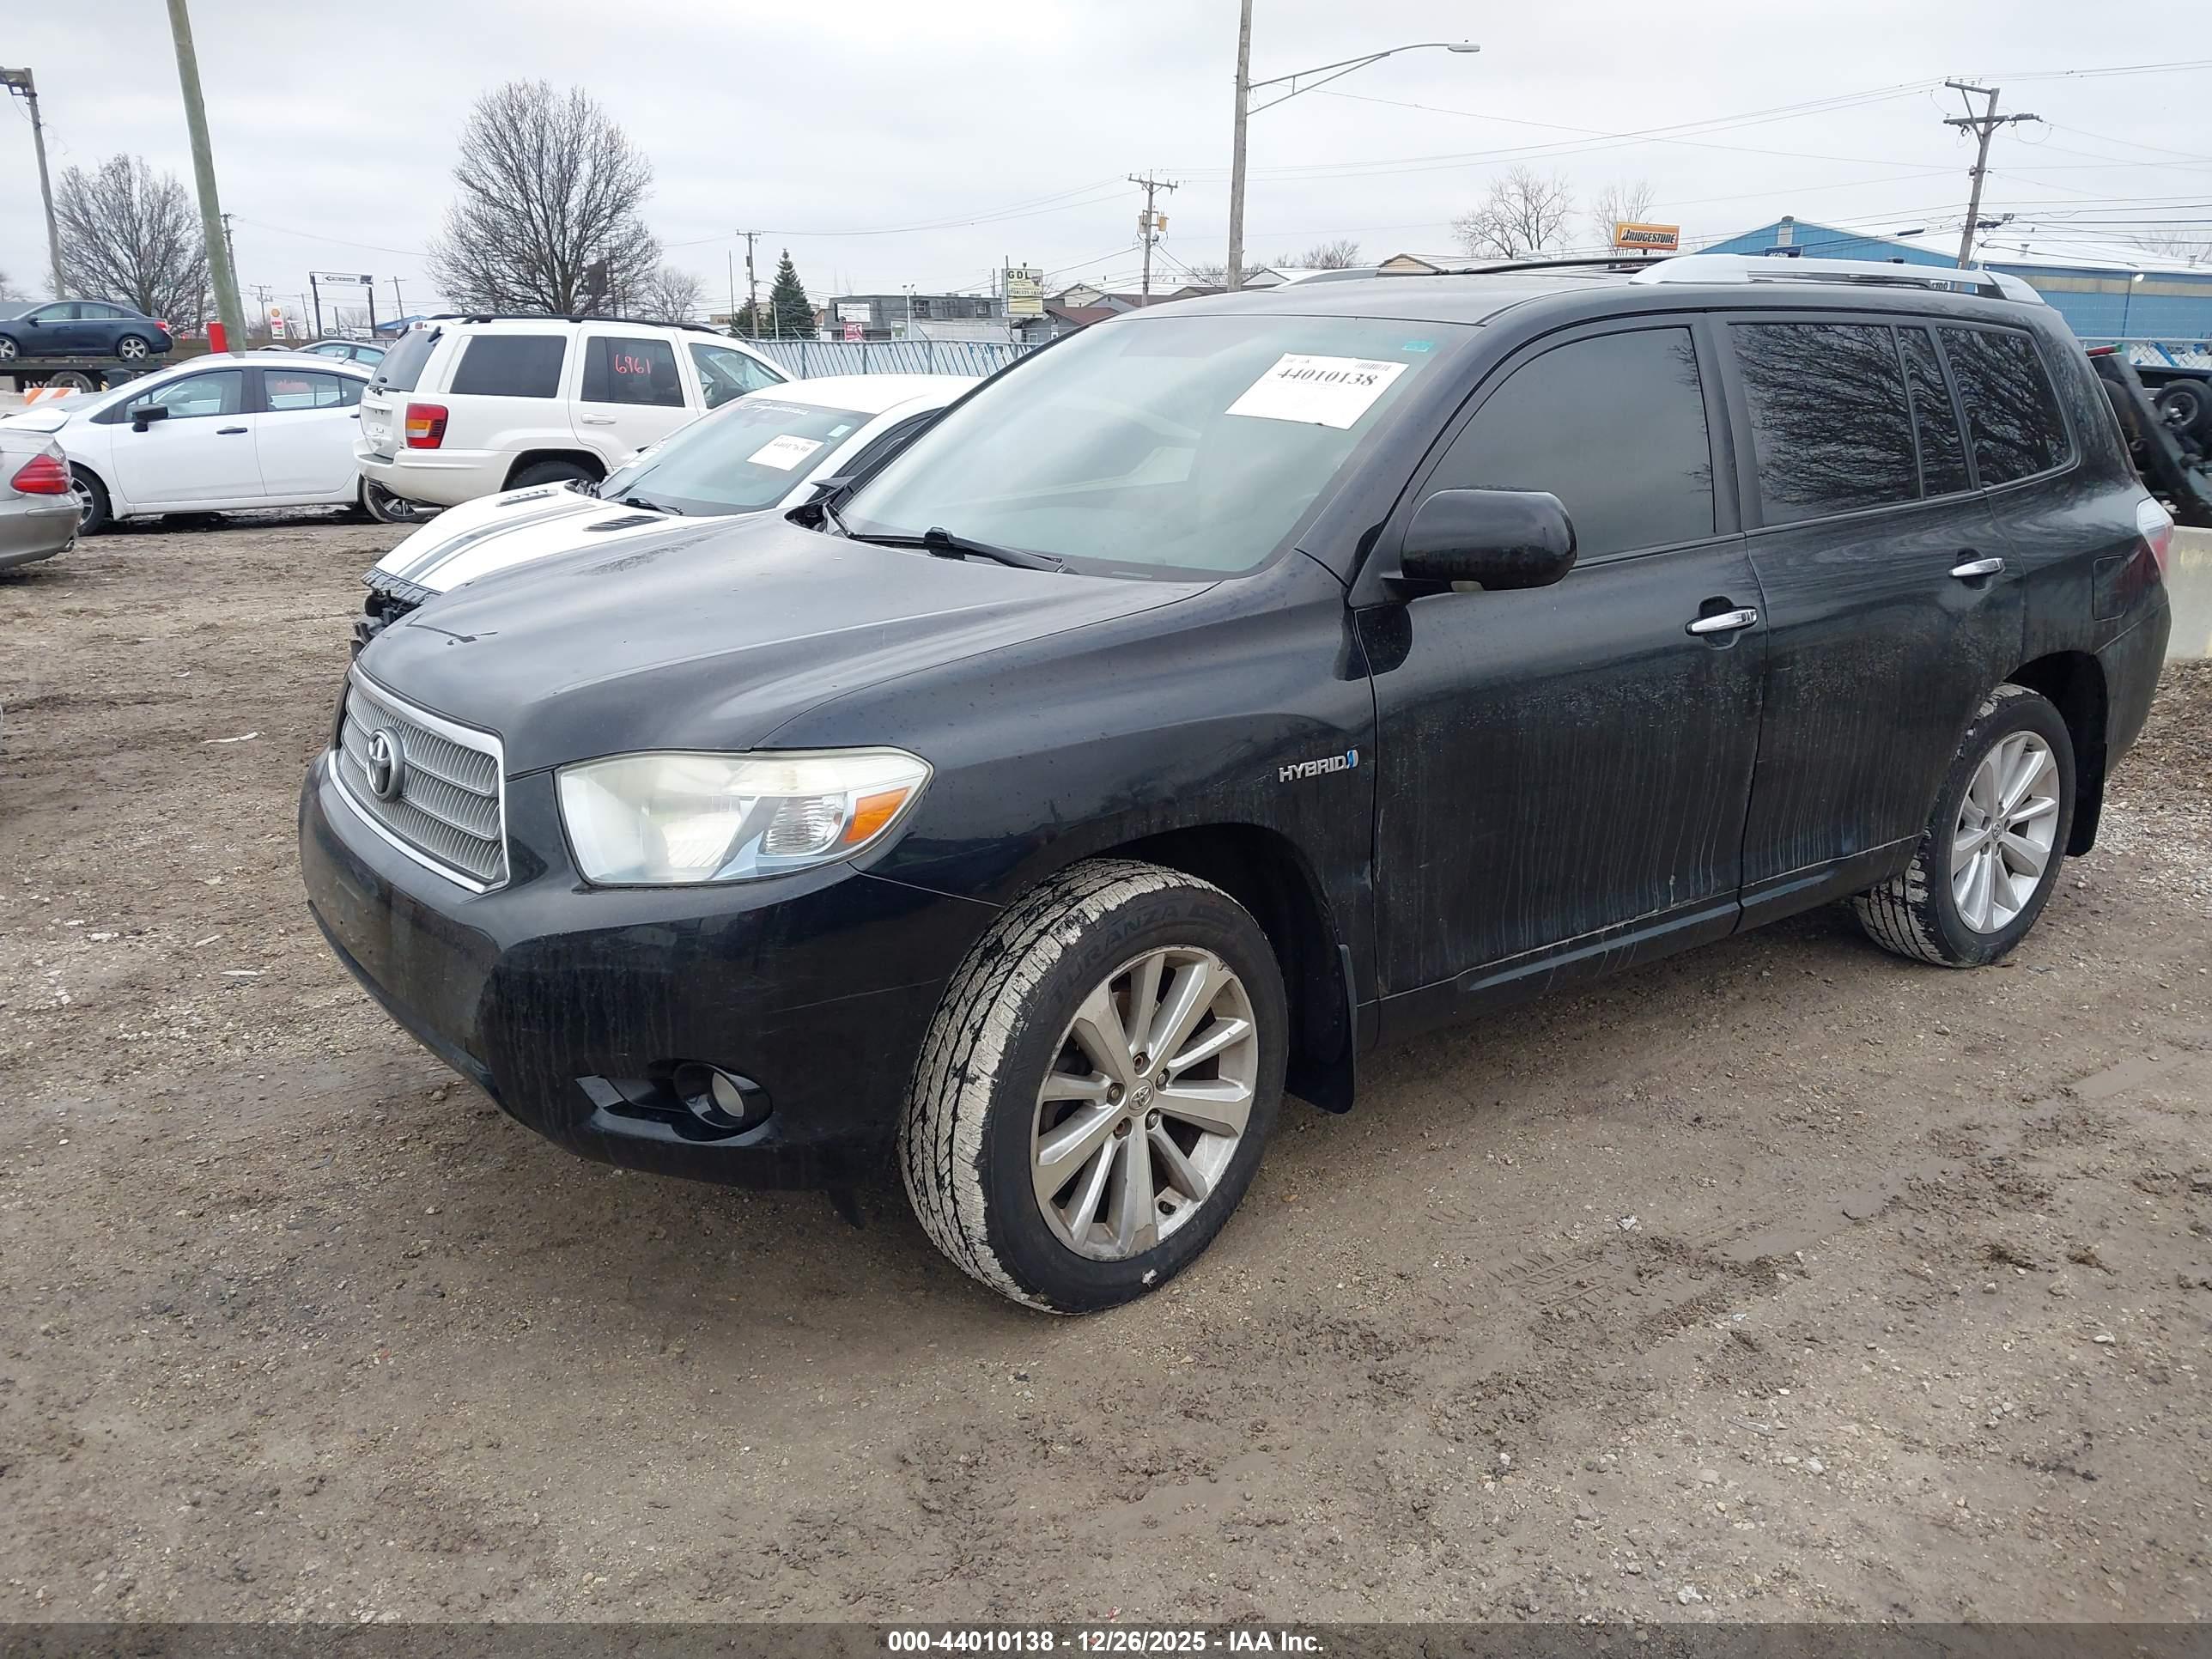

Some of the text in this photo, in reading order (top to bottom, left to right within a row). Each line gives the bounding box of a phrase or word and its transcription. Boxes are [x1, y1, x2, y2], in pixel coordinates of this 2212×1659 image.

[1621, 229, 1675, 244] BRIDGESTONE
[1008, 270, 1030, 279] GDL
[615, 354, 651, 374] 6961
[1277, 368, 1378, 386] 44010138
[1278, 755, 1347, 783] HYBRID
